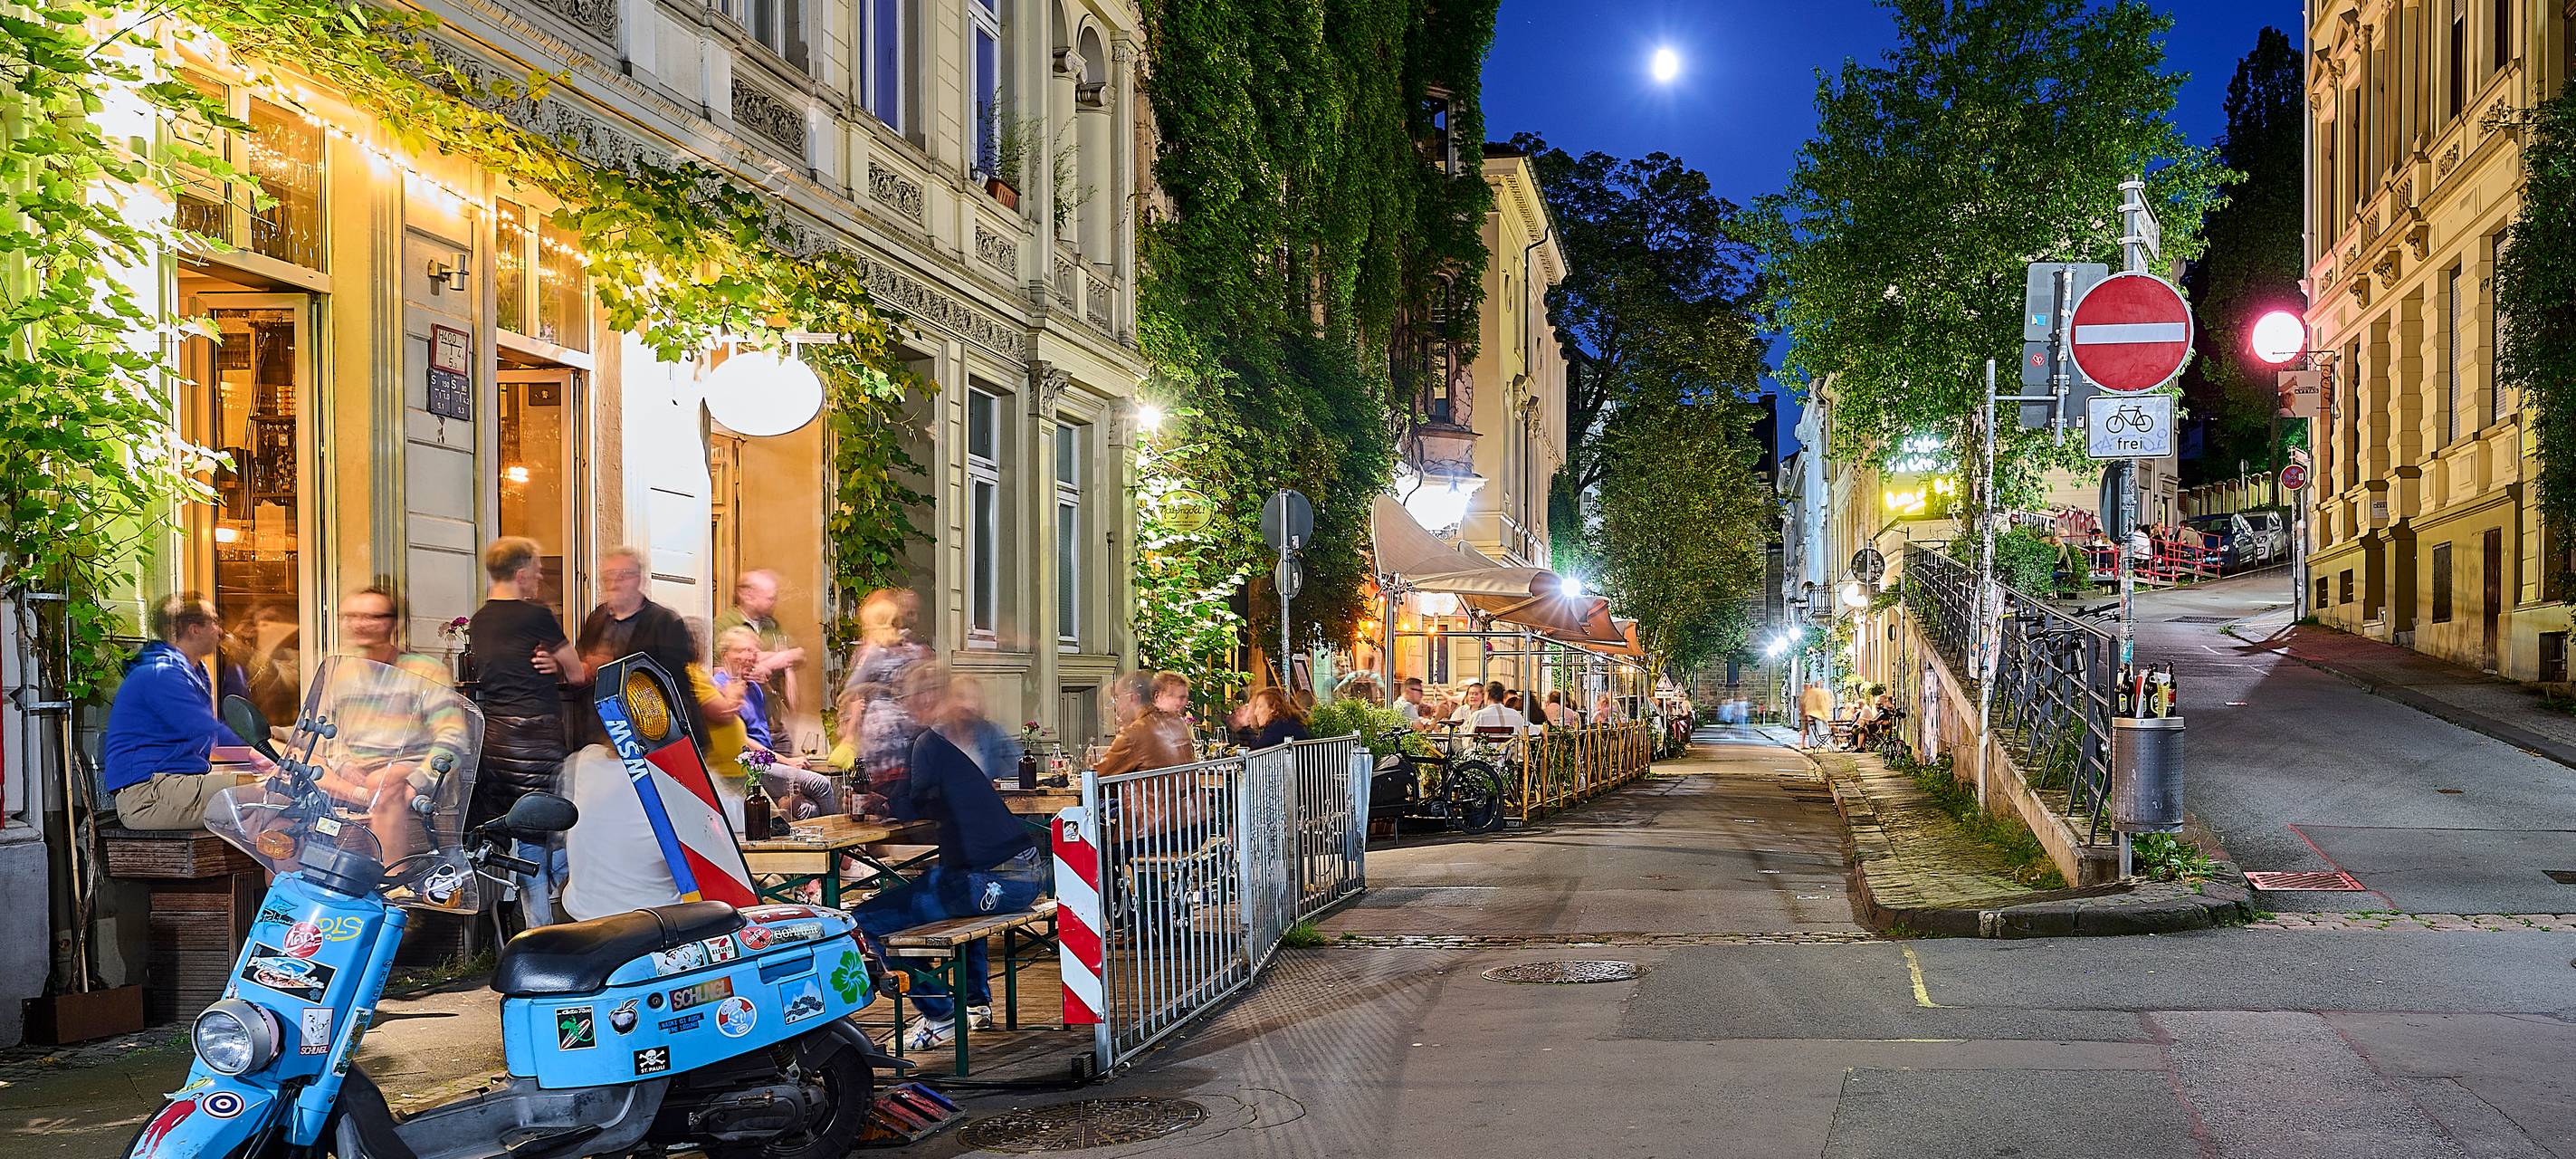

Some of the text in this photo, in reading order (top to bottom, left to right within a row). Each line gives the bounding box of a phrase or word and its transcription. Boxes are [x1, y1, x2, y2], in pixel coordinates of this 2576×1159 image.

[438, 330, 456, 344] H400
[431, 374, 450, 388] S 150
[451, 379, 457, 389] S
[2117, 437, 2142, 450] frei
[606, 720, 649, 782] MSM
[774, 924, 818, 939] SOMMER
